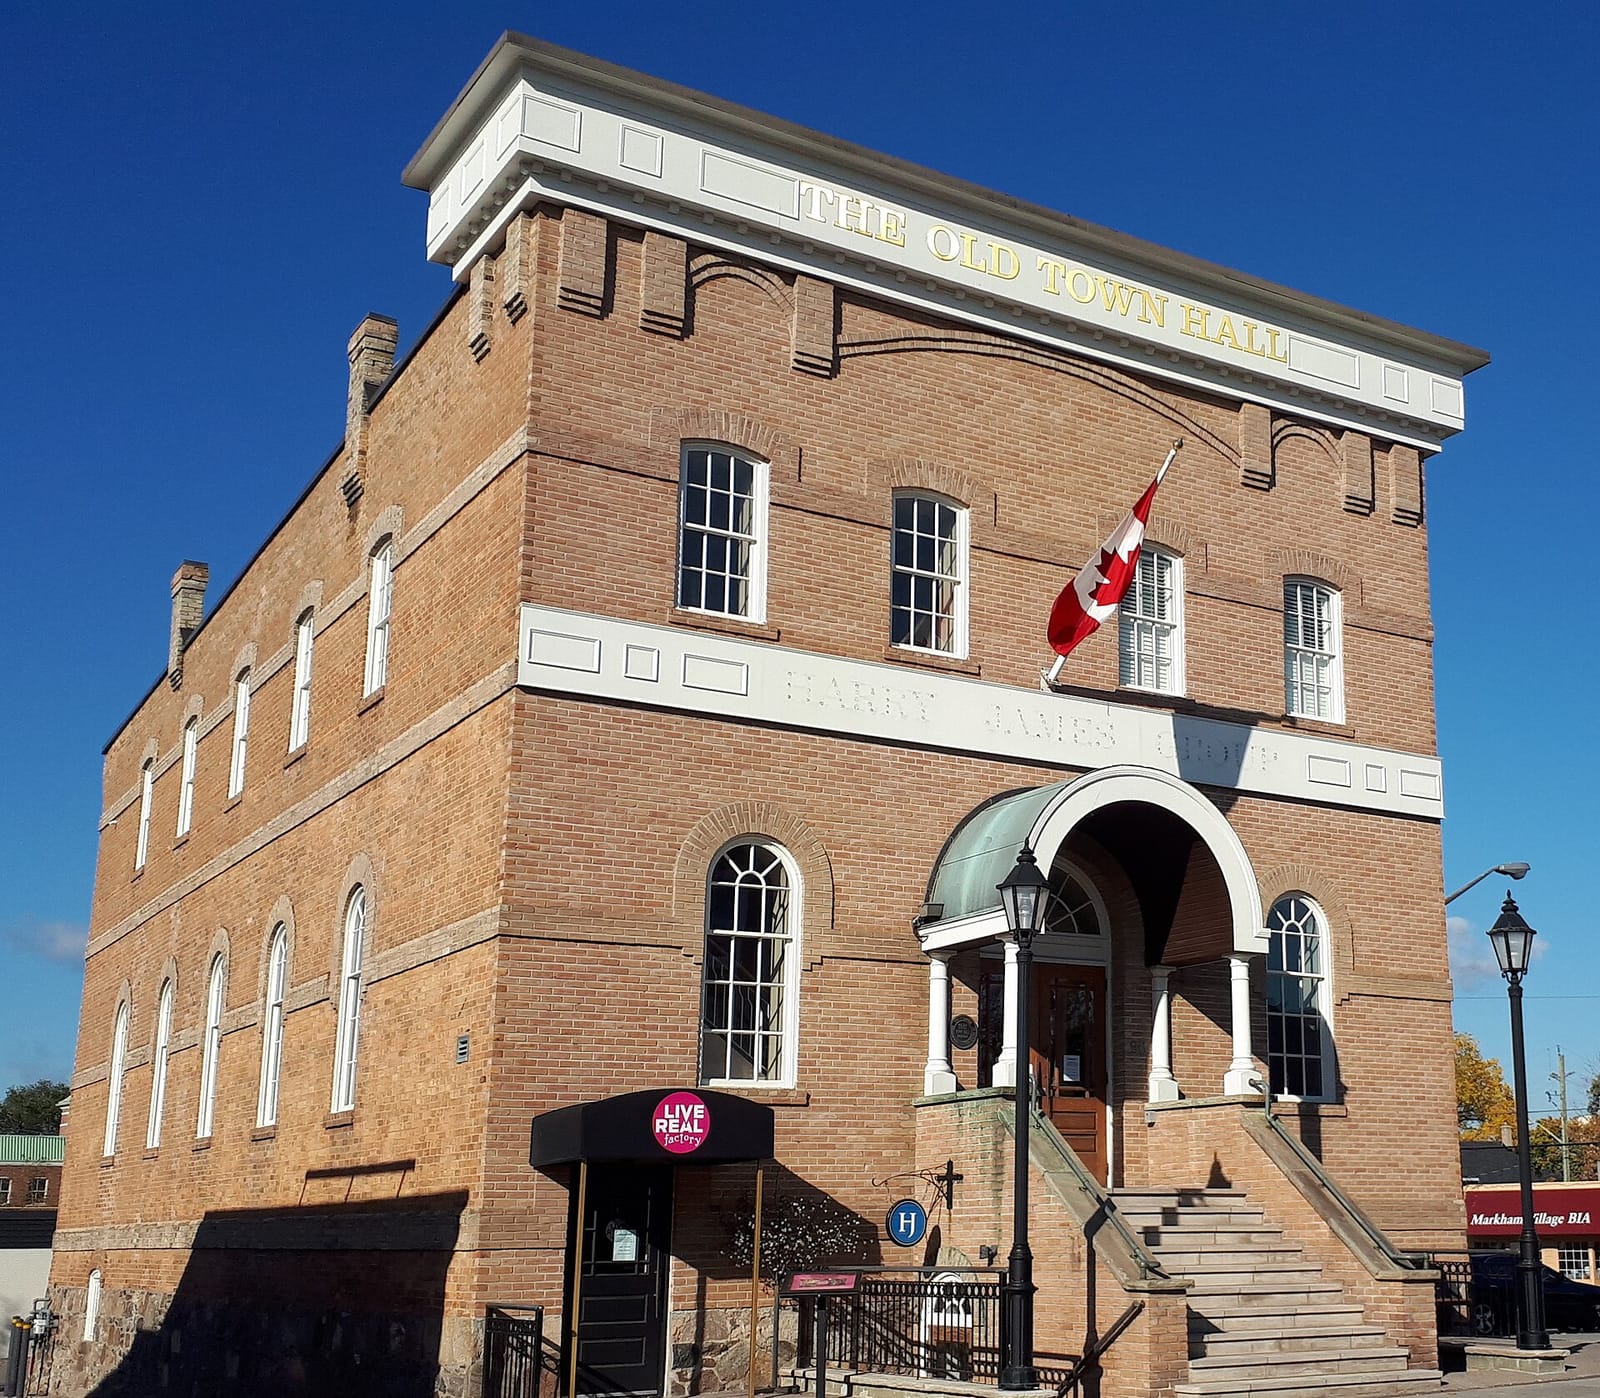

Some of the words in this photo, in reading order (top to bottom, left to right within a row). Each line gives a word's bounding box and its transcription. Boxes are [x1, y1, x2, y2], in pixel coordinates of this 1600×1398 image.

[800, 180, 907, 248] THE
[926, 224, 1021, 281] OLD
[1036, 255, 1169, 328] TOWN
[1179, 302, 1288, 363] HALL
[664, 1104, 704, 1121] LIVE
[655, 1119, 703, 1133] REAL
[664, 1134, 701, 1147] factory
[898, 1212, 917, 1238] HJ
[1470, 1213, 1524, 1225] Markham
[1532, 1212, 1564, 1227] illage
[1567, 1212, 1591, 1224] BIA
